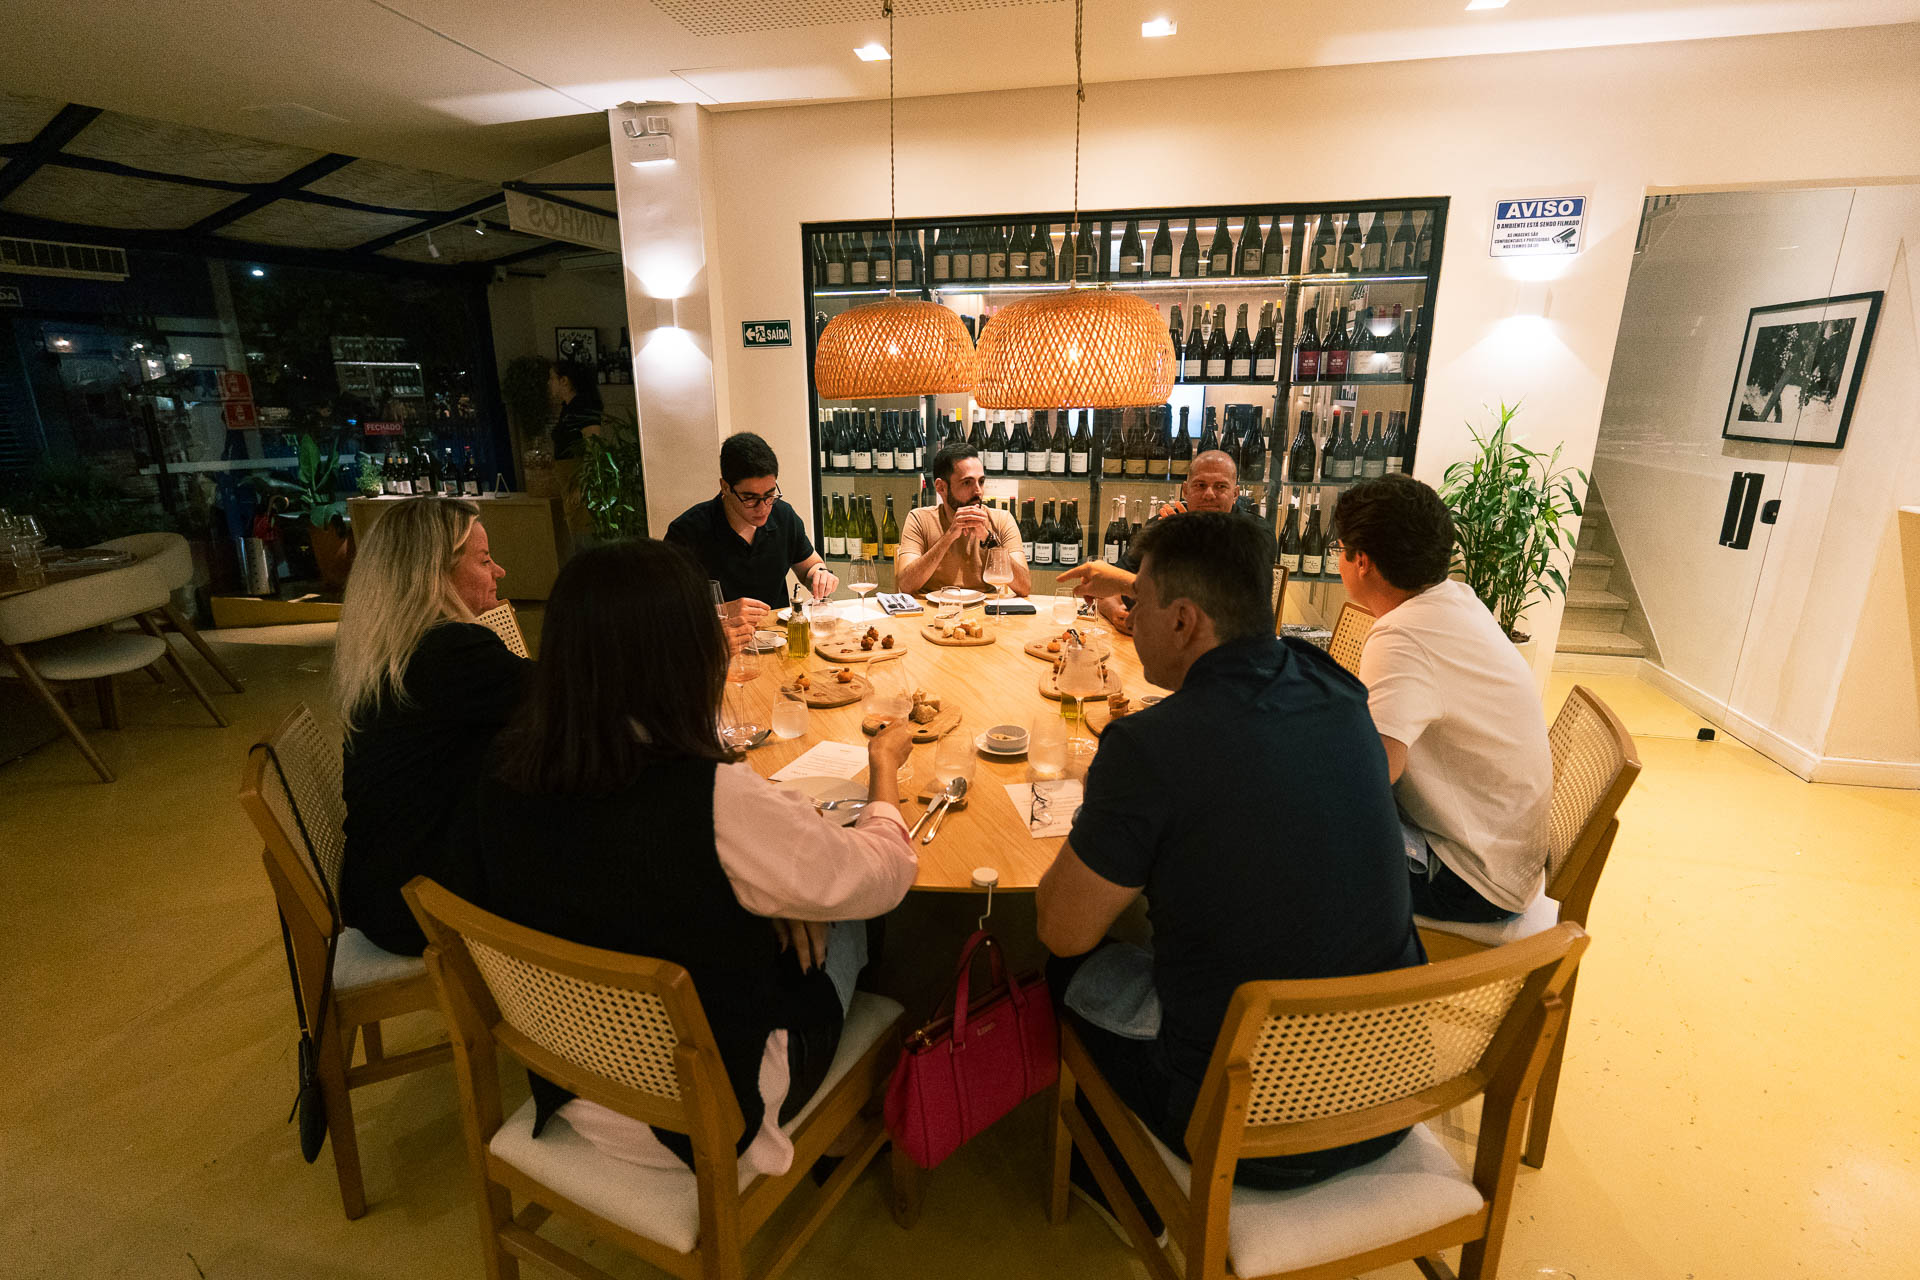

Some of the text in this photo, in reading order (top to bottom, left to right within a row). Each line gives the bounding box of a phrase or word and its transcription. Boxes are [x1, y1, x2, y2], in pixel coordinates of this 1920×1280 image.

[1505, 200, 1574, 219] AVISO
[1540, 220, 1556, 228] SENDO
[766, 326, 789, 340] SAÍDA
[366, 423, 400, 432] FECHADO
